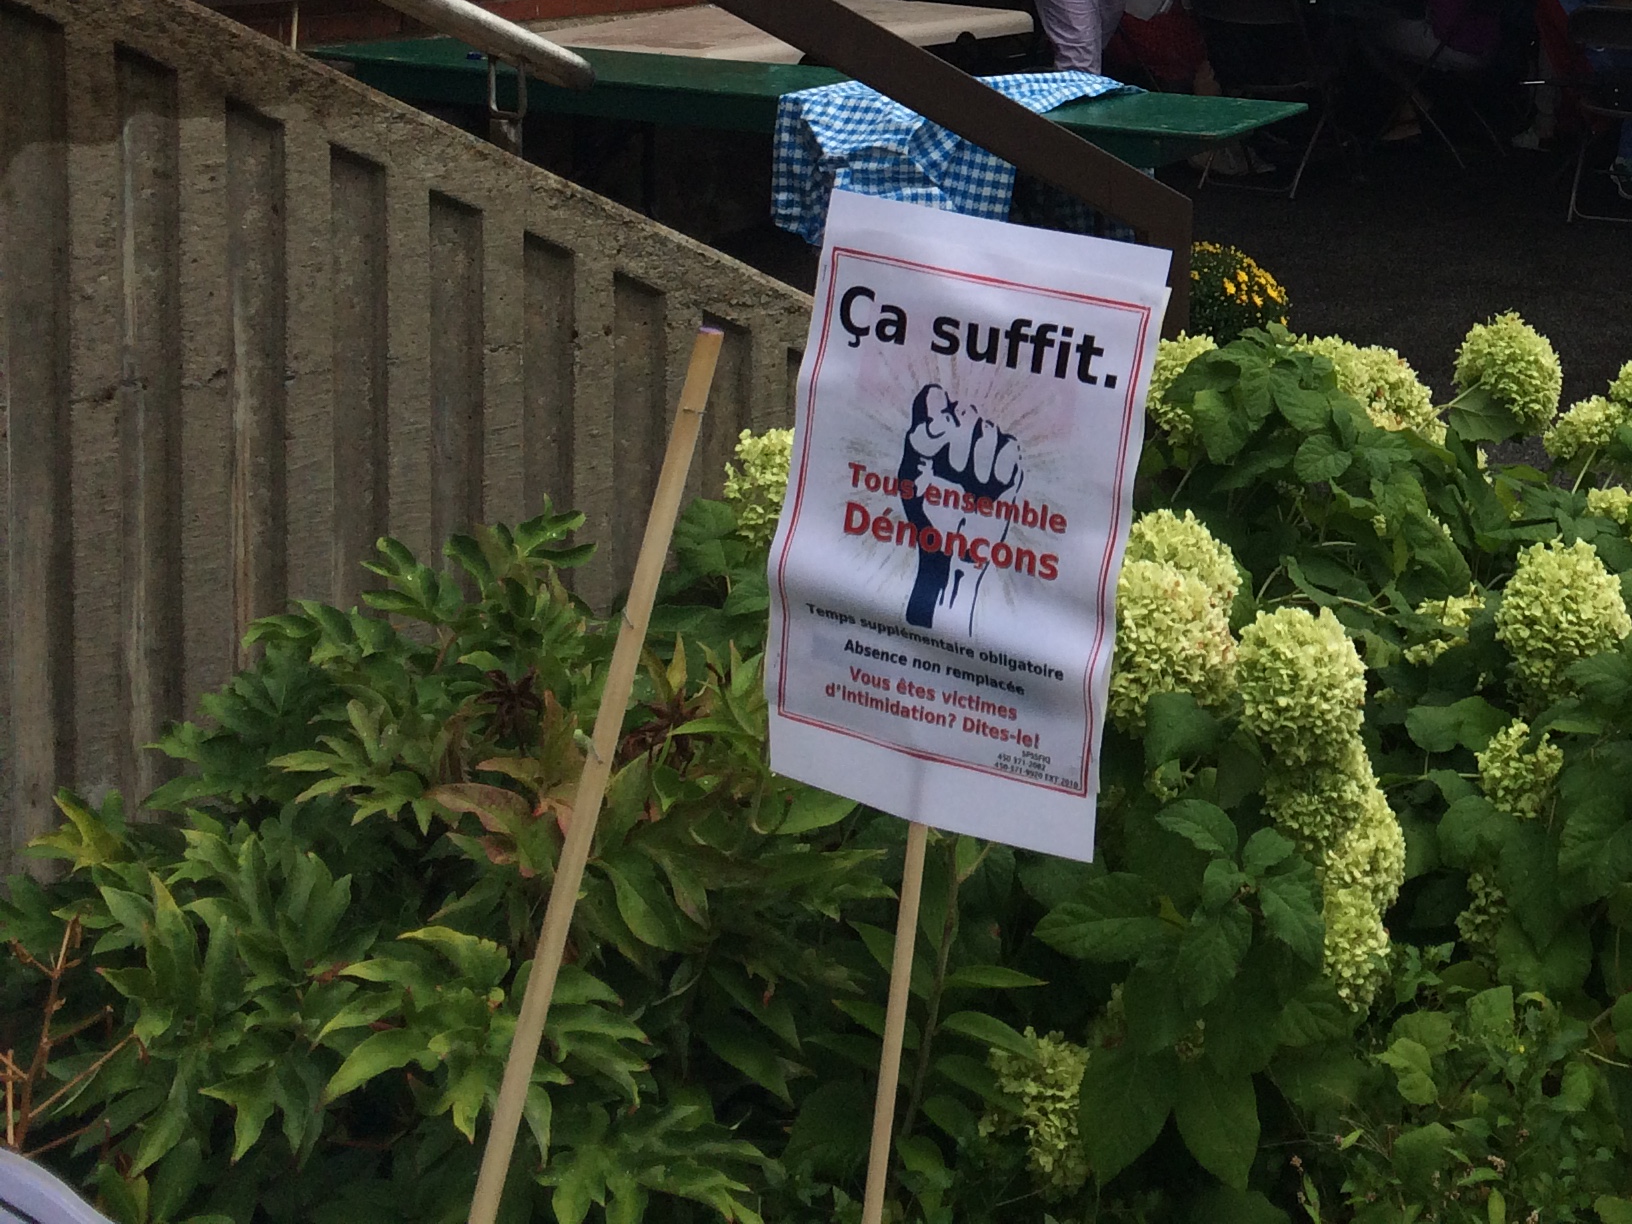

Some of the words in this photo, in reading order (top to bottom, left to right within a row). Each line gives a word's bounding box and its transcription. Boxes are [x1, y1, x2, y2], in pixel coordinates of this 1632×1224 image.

[839, 286, 908, 348] Ça
[930, 316, 1117, 389] suffit.
[848, 462, 915, 500] Tous
[924, 483, 1068, 534] ensemble
[843, 501, 1059, 581] Dénonçons
[805, 603, 856, 625] Temps
[860, 617, 974, 658] supplémentaire
[979, 649, 1064, 681] obligatoire
[844, 638, 908, 666] Absence
[912, 657, 941, 674] non
[945, 665, 1025, 695] remplacée
[849, 665, 891, 692] Vous
[896, 677, 936, 701] êtes
[942, 690, 1018, 721] victimes
[962, 716, 1040, 749] Dites-le!
